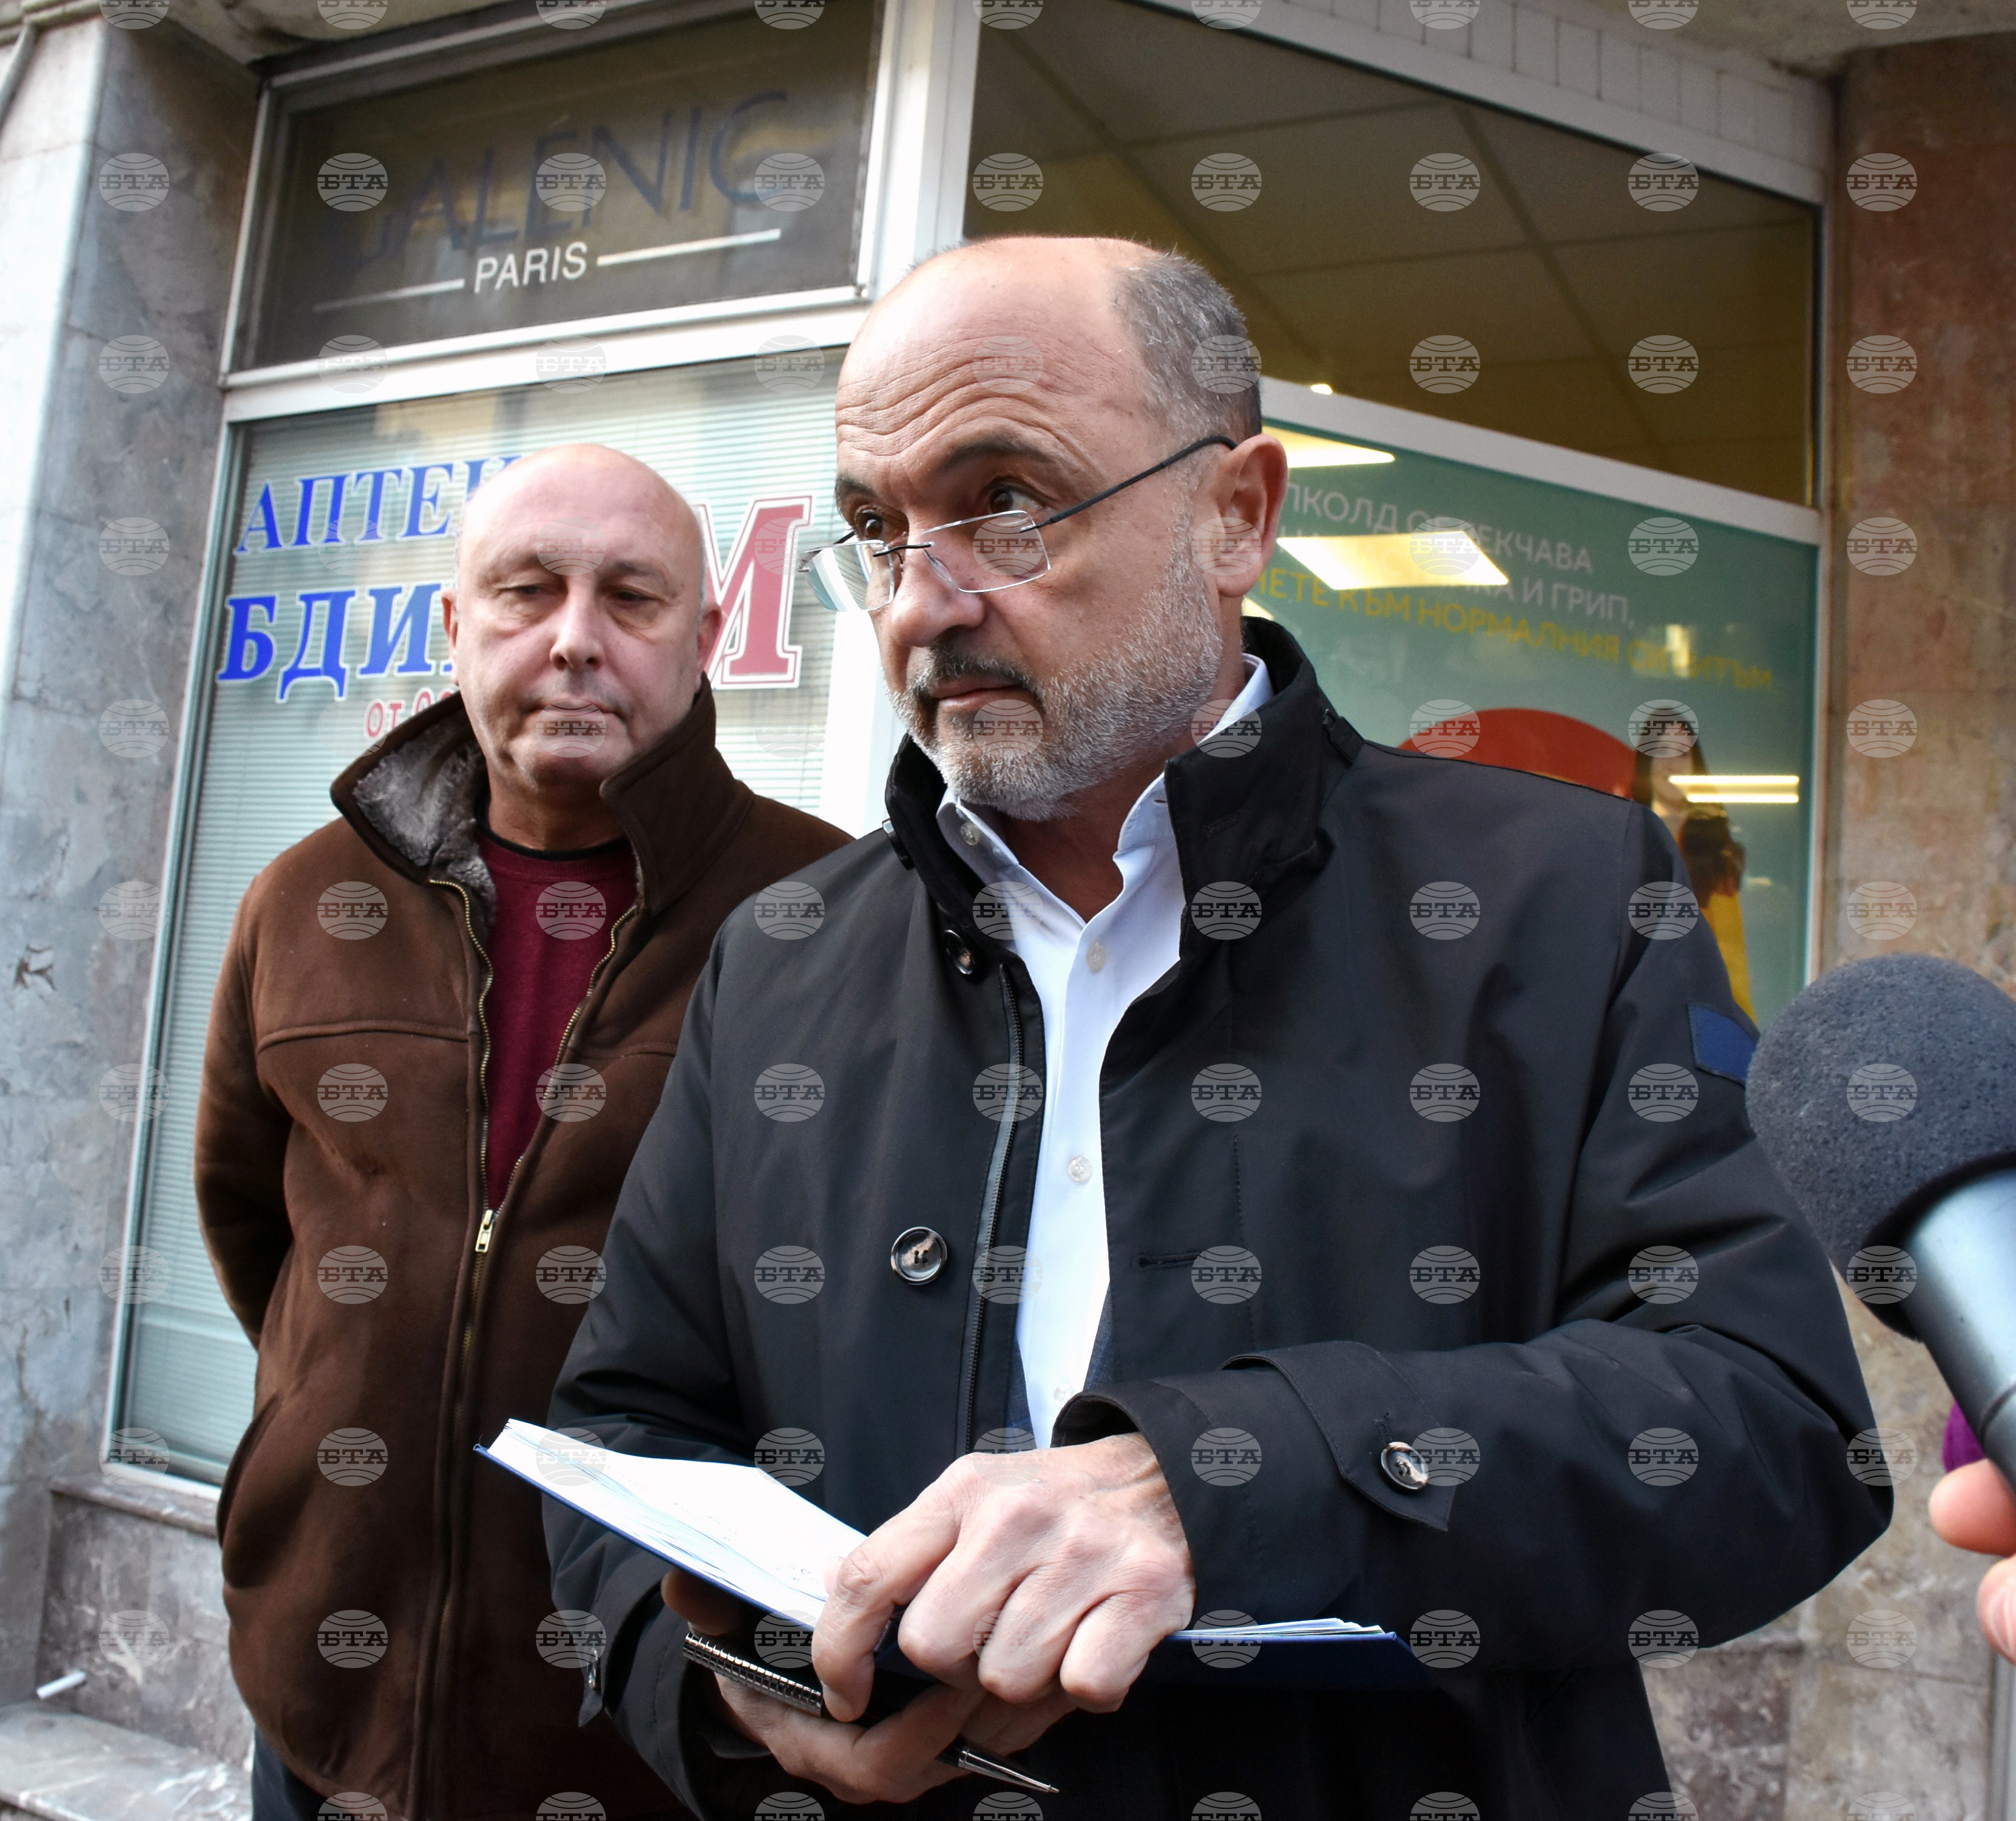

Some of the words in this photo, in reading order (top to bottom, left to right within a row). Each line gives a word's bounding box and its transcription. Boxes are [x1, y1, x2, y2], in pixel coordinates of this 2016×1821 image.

[474, 241, 588, 295] PARIS
[1523, 577, 1544, 605] И
[217, 582, 455, 700] БДИ
